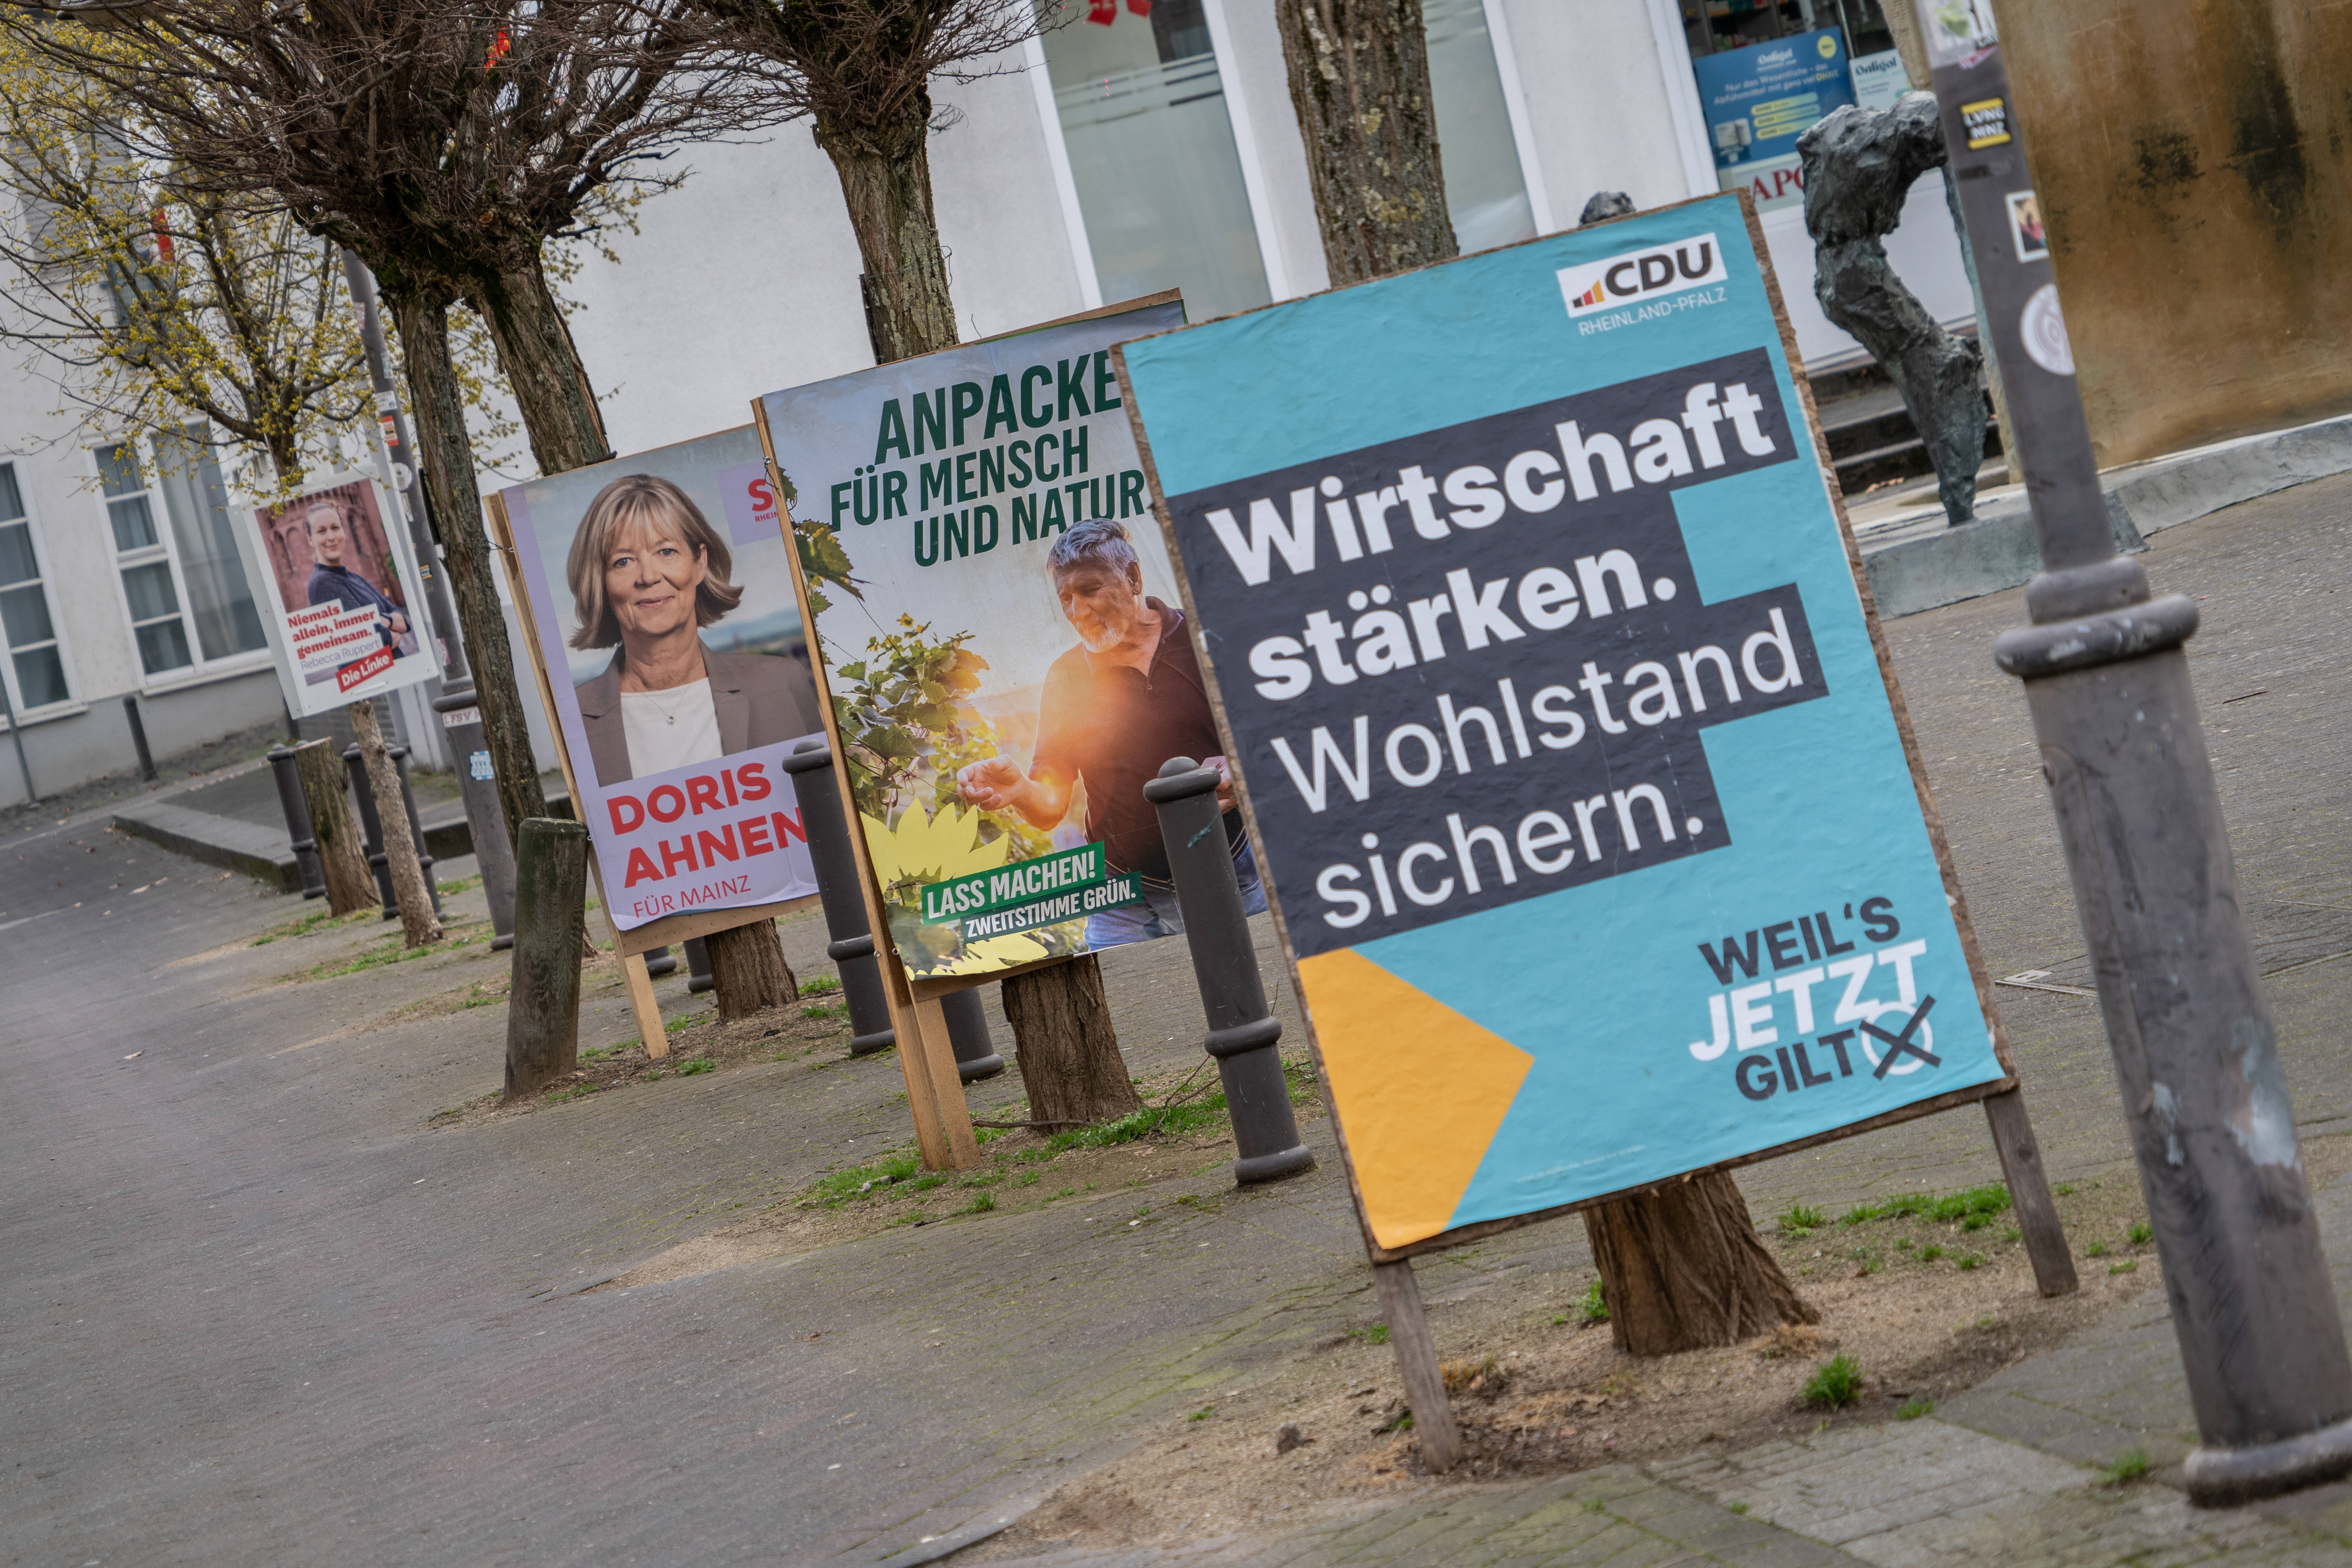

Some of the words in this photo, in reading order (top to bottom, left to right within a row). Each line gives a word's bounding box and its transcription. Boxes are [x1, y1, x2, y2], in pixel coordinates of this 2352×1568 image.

[1855, 56, 1897, 75] Onligol
[1964, 106, 2005, 127] LVNG
[1969, 122, 2005, 140] MNZ
[1605, 242, 1713, 296] CDU
[1578, 287, 1728, 336] RHEINLAND-PFALZ
[831, 464, 908, 533] FÜR
[920, 425, 1088, 512] MENSCH
[1205, 382, 1776, 587] Wirtschaft
[914, 504, 998, 567] UND
[287, 605, 340, 628] Niemals
[292, 624, 333, 642] allein,
[333, 611, 375, 630] immer
[297, 628, 372, 660] gemeinsam.
[1248, 548, 1677, 701] stärken.
[300, 652, 341, 670] Rebecca
[342, 639, 380, 657] Ruppert
[341, 670, 360, 686] Die
[360, 655, 389, 676] Linke
[1271, 606, 1804, 813] Wohlstand
[606, 762, 771, 836] DORIS
[624, 806, 807, 888] AHNEN
[1316, 782, 1704, 929] sichern.
[633, 895, 673, 918] FÜR
[681, 875, 752, 909] MAINZ
[927, 880, 985, 919] LASS
[991, 850, 1096, 903] MACHEN!
[965, 892, 1080, 938] ZWEITSTIMME
[1083, 878, 1136, 910] GRÜN.
[1689, 939, 1927, 1062] JETZT
[1735, 1029, 1856, 1101] GILT
